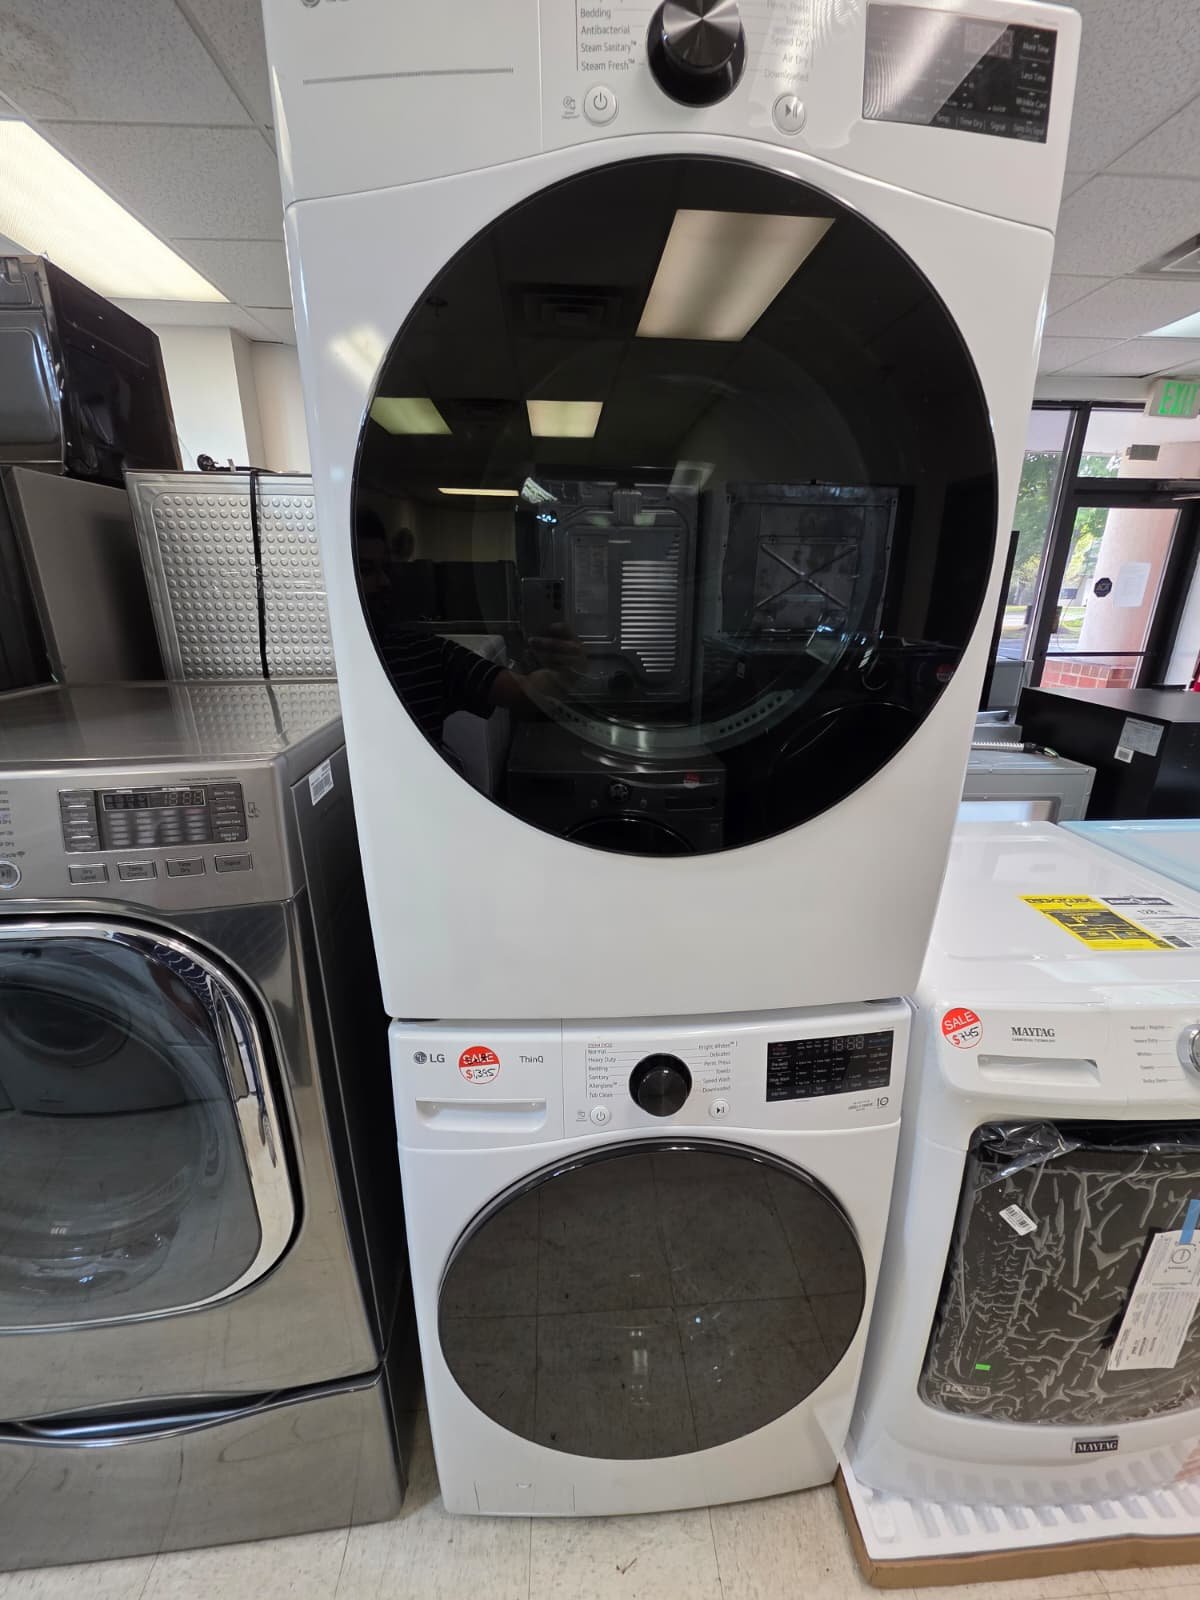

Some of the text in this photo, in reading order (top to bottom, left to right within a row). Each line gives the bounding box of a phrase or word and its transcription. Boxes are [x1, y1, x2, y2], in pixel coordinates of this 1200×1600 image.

[580, 8, 612, 19] Bedding
[580, 25, 630, 35] Antibacterial
[580, 43, 602, 52] Steam
[580, 61, 606, 71] Steam
[944, 1011, 974, 1031] SALE
[1011, 1027, 1055, 1037] MAYTAG
[430, 1054, 445, 1063] LG
[520, 1056, 544, 1064] ThinQ
[1077, 1442, 1117, 1451] MAYTAG
